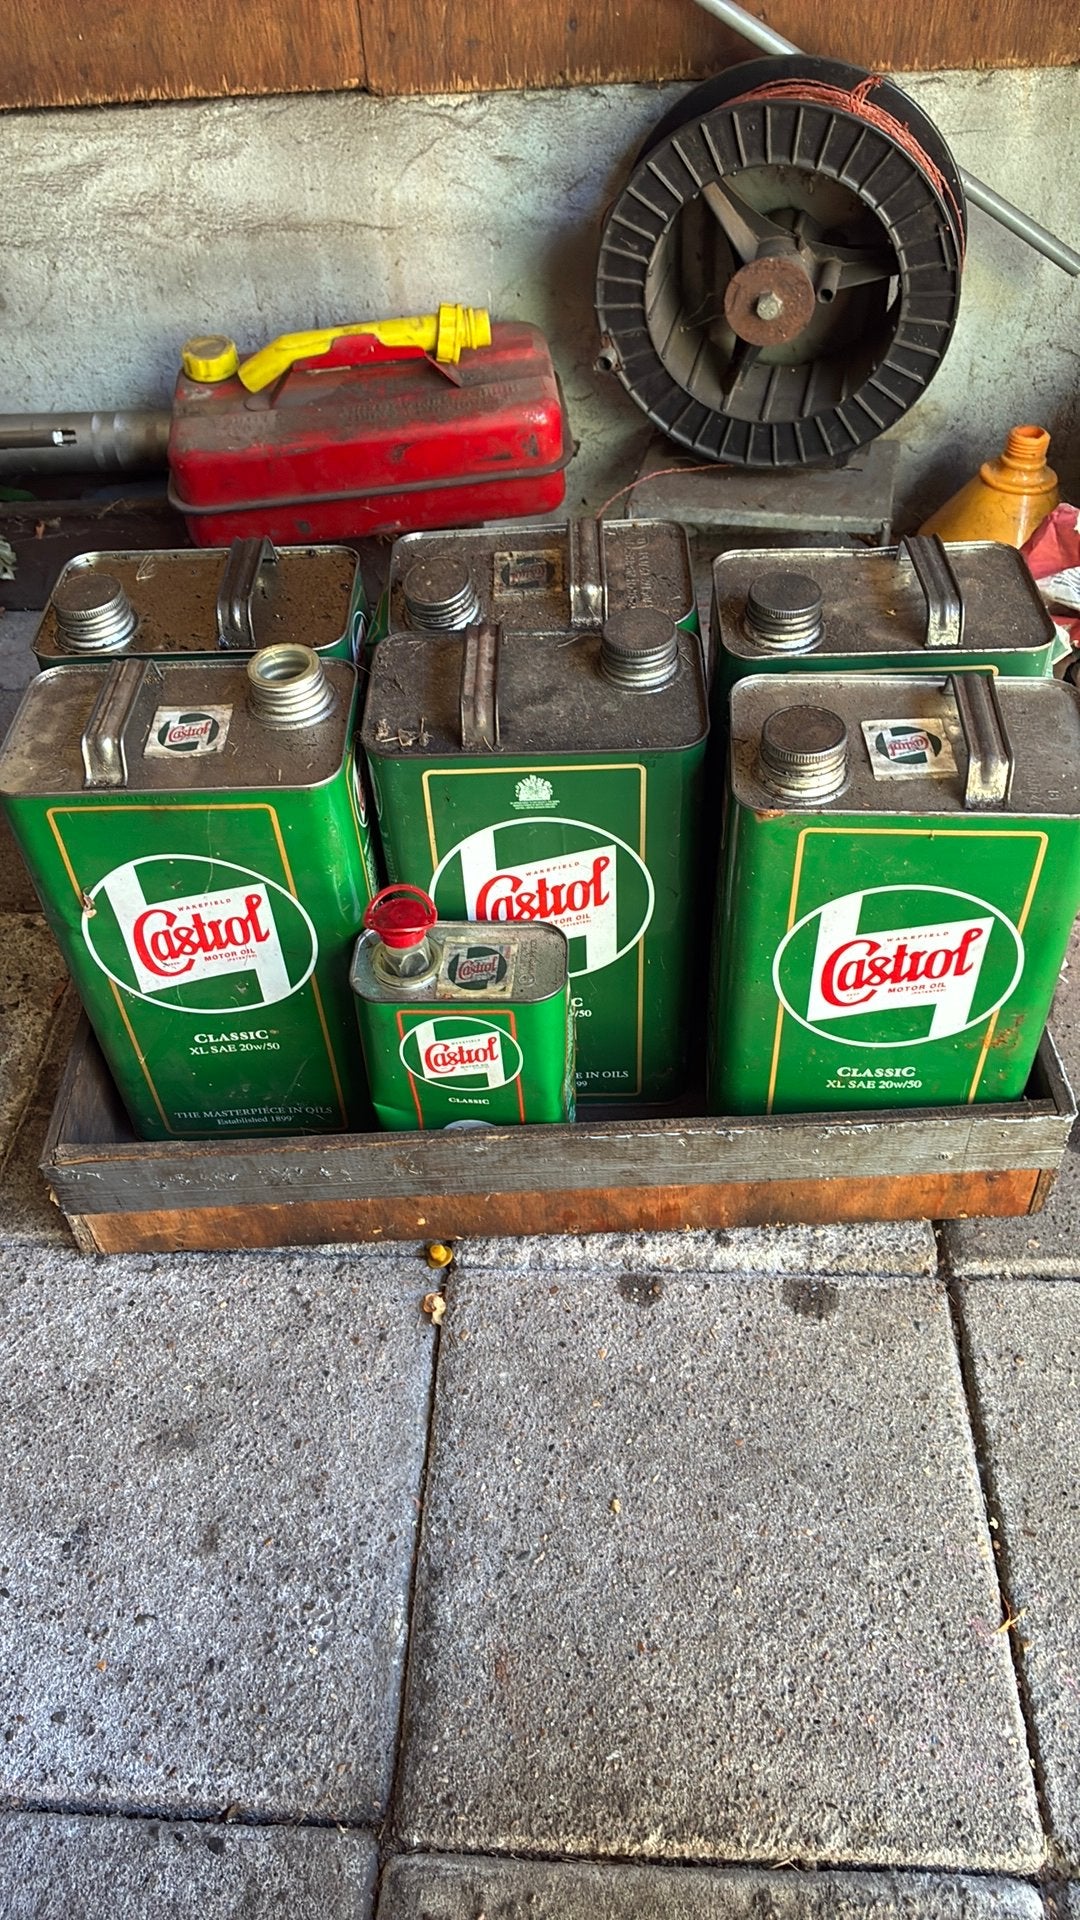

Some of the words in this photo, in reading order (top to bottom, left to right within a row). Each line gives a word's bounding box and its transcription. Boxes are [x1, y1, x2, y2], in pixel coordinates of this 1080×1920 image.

[168, 721, 212, 743] Castrol
[888, 735, 929, 756] Castrol
[526, 861, 580, 876] WAKEFIELD
[475, 855, 610, 921] Castrol
[177, 898, 232, 912] WAKEFIELD
[575, 913, 591, 921] OIL
[133, 893, 270, 977] Castrol
[886, 931, 950, 942] WAKEFIELD
[204, 951, 238, 962] MOTOR
[240, 948, 256, 956] OIL
[458, 956, 498, 981] Castrol
[820, 927, 984, 1007] Castrol
[887, 984, 926, 993] MOTOR
[193, 1029, 270, 1044] CLASSIC
[189, 1047, 209, 1056] XL
[210, 1044, 237, 1054] SAE
[240, 1042, 281, 1052] 20w/50
[424, 1036, 499, 1074] Castrol
[585, 1071, 600, 1079] IN
[602, 1070, 629, 1078] OILS
[836, 1066, 917, 1078] CLASSIC
[825, 1079, 846, 1089] XL
[847, 1080, 876, 1089] SAE
[878, 1079, 923, 1089] 20w/50
[448, 1097, 490, 1105] CLASSIC
[203, 1106, 287, 1119] MASTERPIECE
[288, 1106, 302, 1115] IN
[305, 1106, 333, 1115] OILS
[217, 1115, 270, 1126] Established
